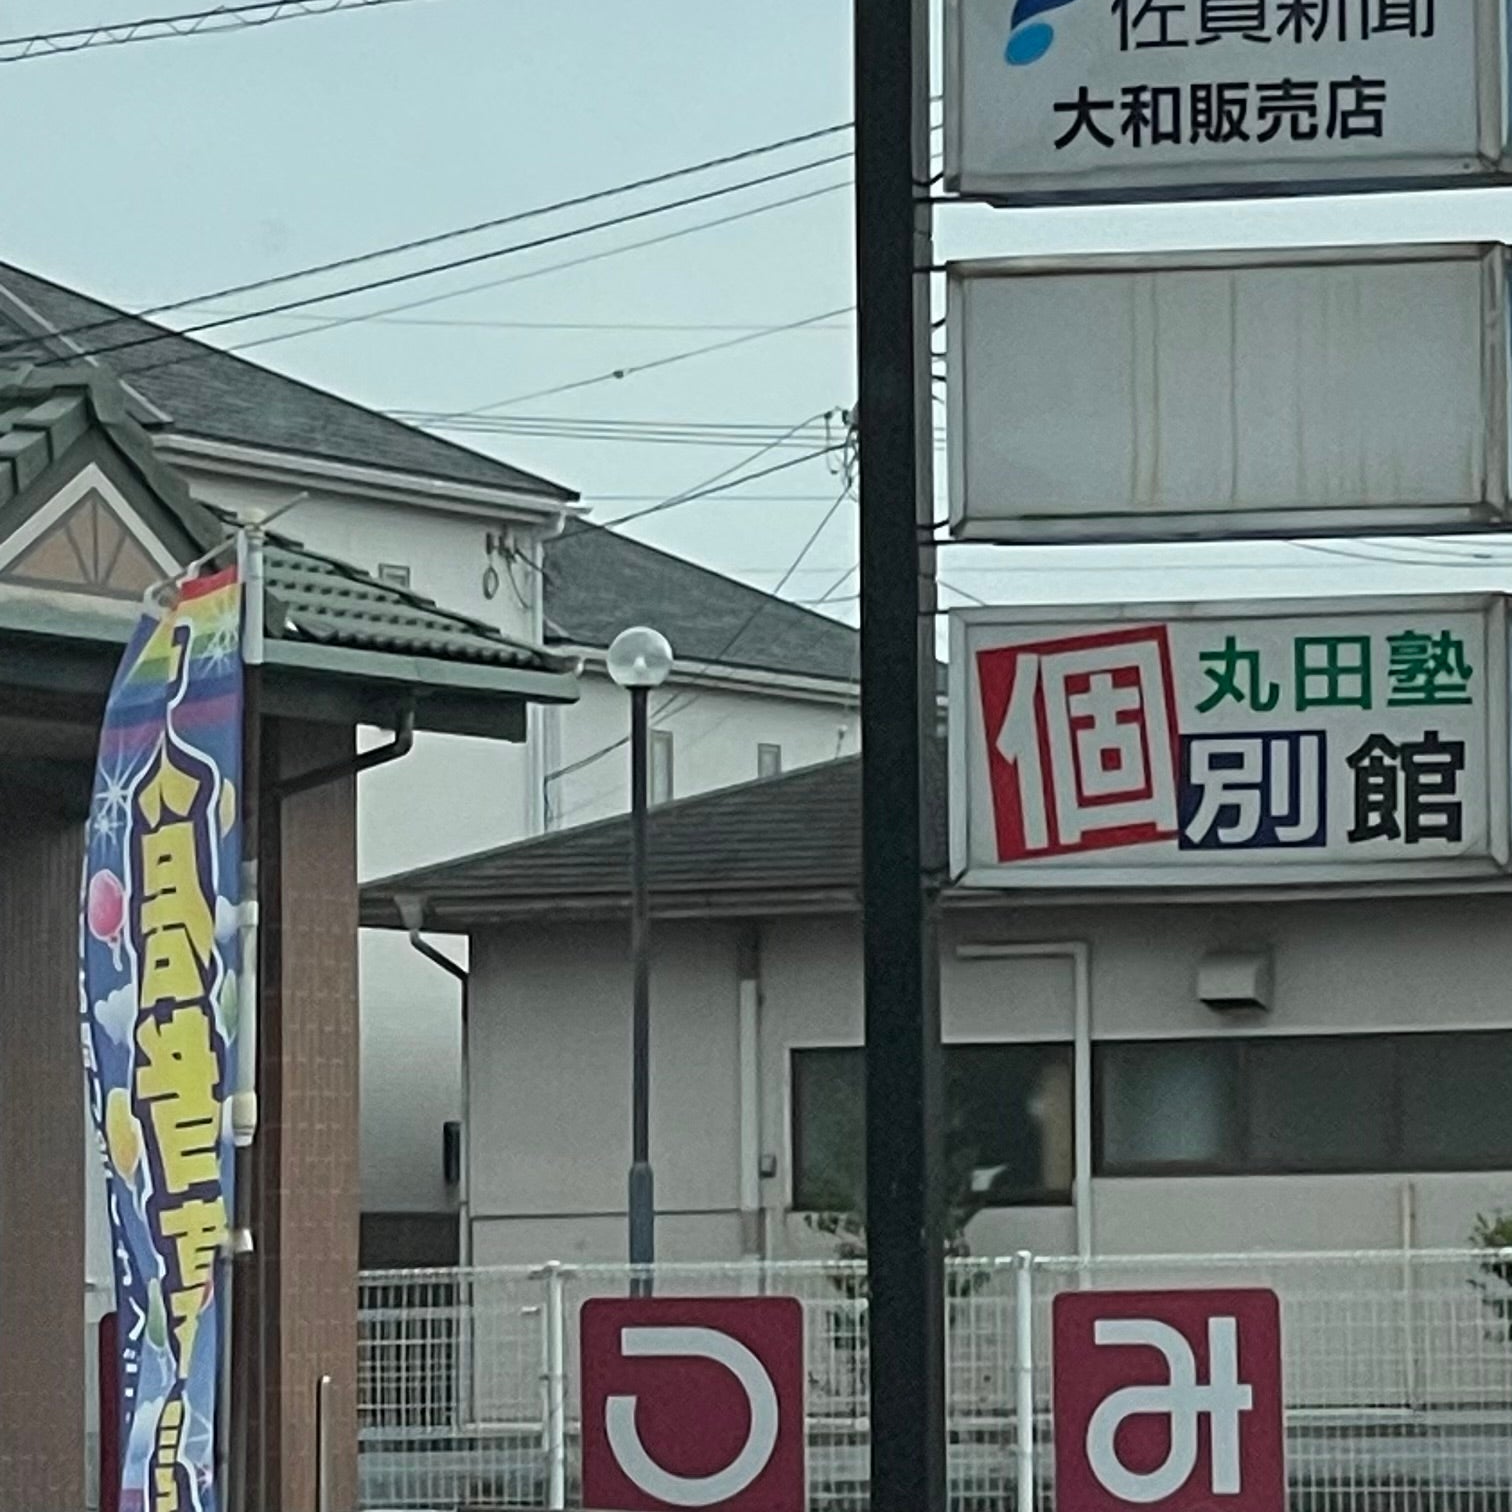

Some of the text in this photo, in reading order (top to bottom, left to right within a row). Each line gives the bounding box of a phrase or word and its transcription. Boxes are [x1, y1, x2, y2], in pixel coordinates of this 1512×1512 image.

[1053, 75, 1387, 150] 大和販売店
[1196, 629, 1474, 714] 丸田塾
